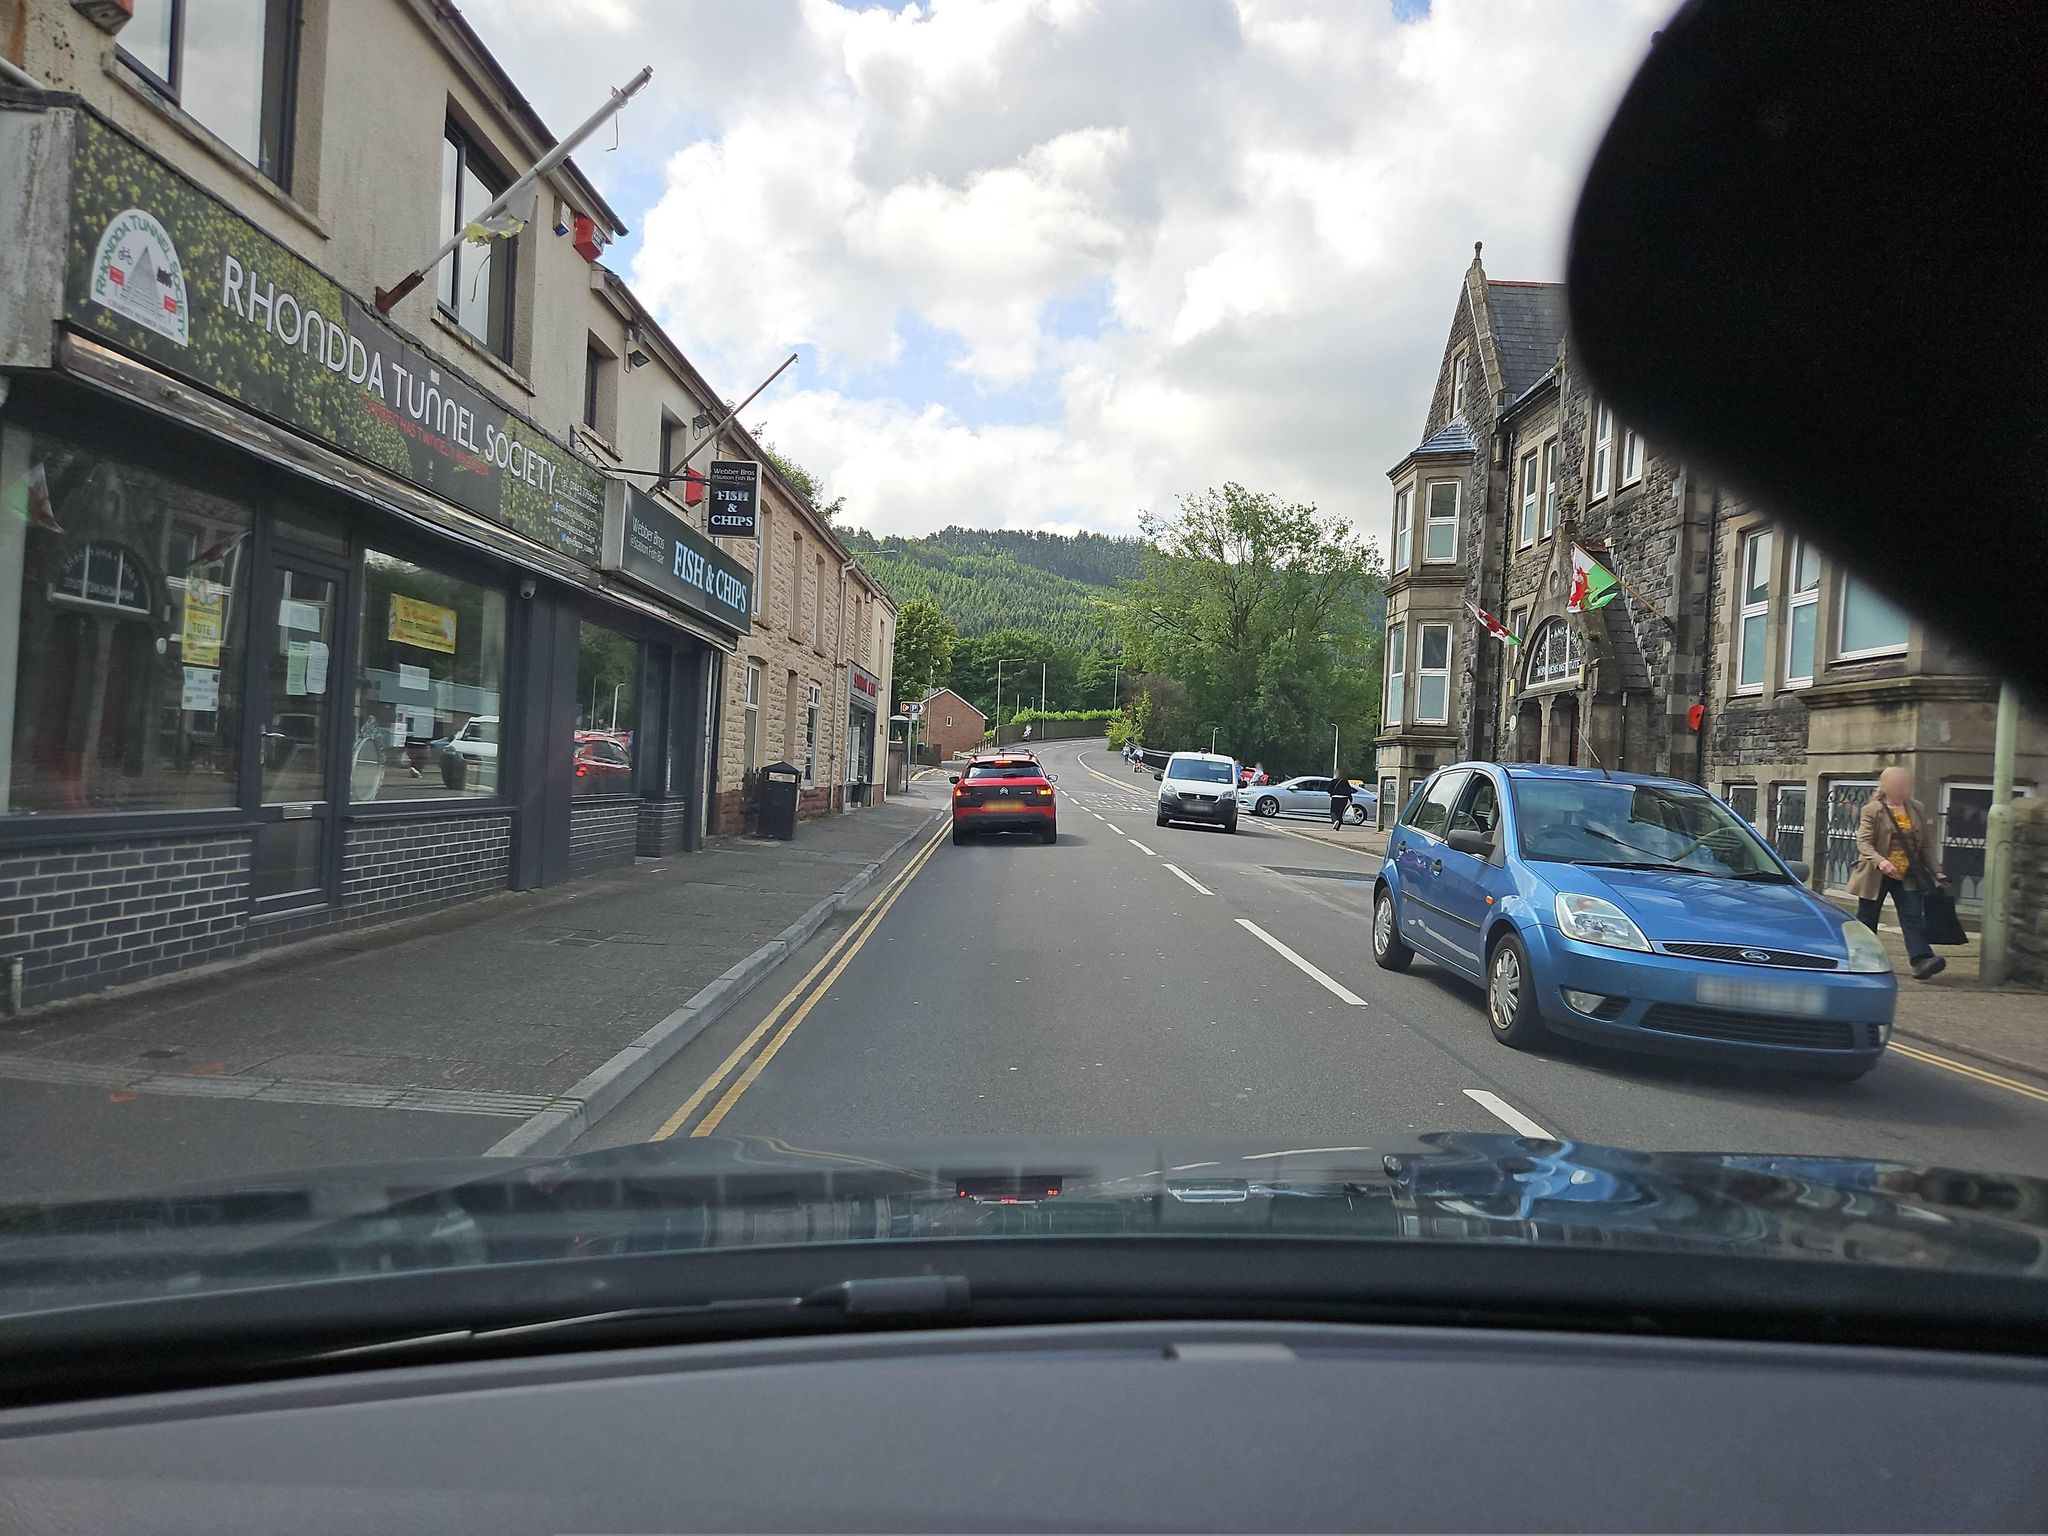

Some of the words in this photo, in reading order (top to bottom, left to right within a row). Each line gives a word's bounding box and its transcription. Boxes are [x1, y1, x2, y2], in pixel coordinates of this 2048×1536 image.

[223, 254, 385, 399] RHONDDA
[391, 363, 480, 454] TUNNEL
[484, 423, 557, 495] SOCIETY
[715, 490, 749, 501] FISH
[727, 503, 738, 513] &
[710, 514, 753, 527] CHIPS
[632, 516, 653, 542] Webber
[653, 530, 665, 550] Bros
[673, 540, 705, 590] FISH
[705, 564, 715, 595] &
[716, 568, 747, 614] CHIPS
[1559, 659, 1581, 673] INSTTUTE
